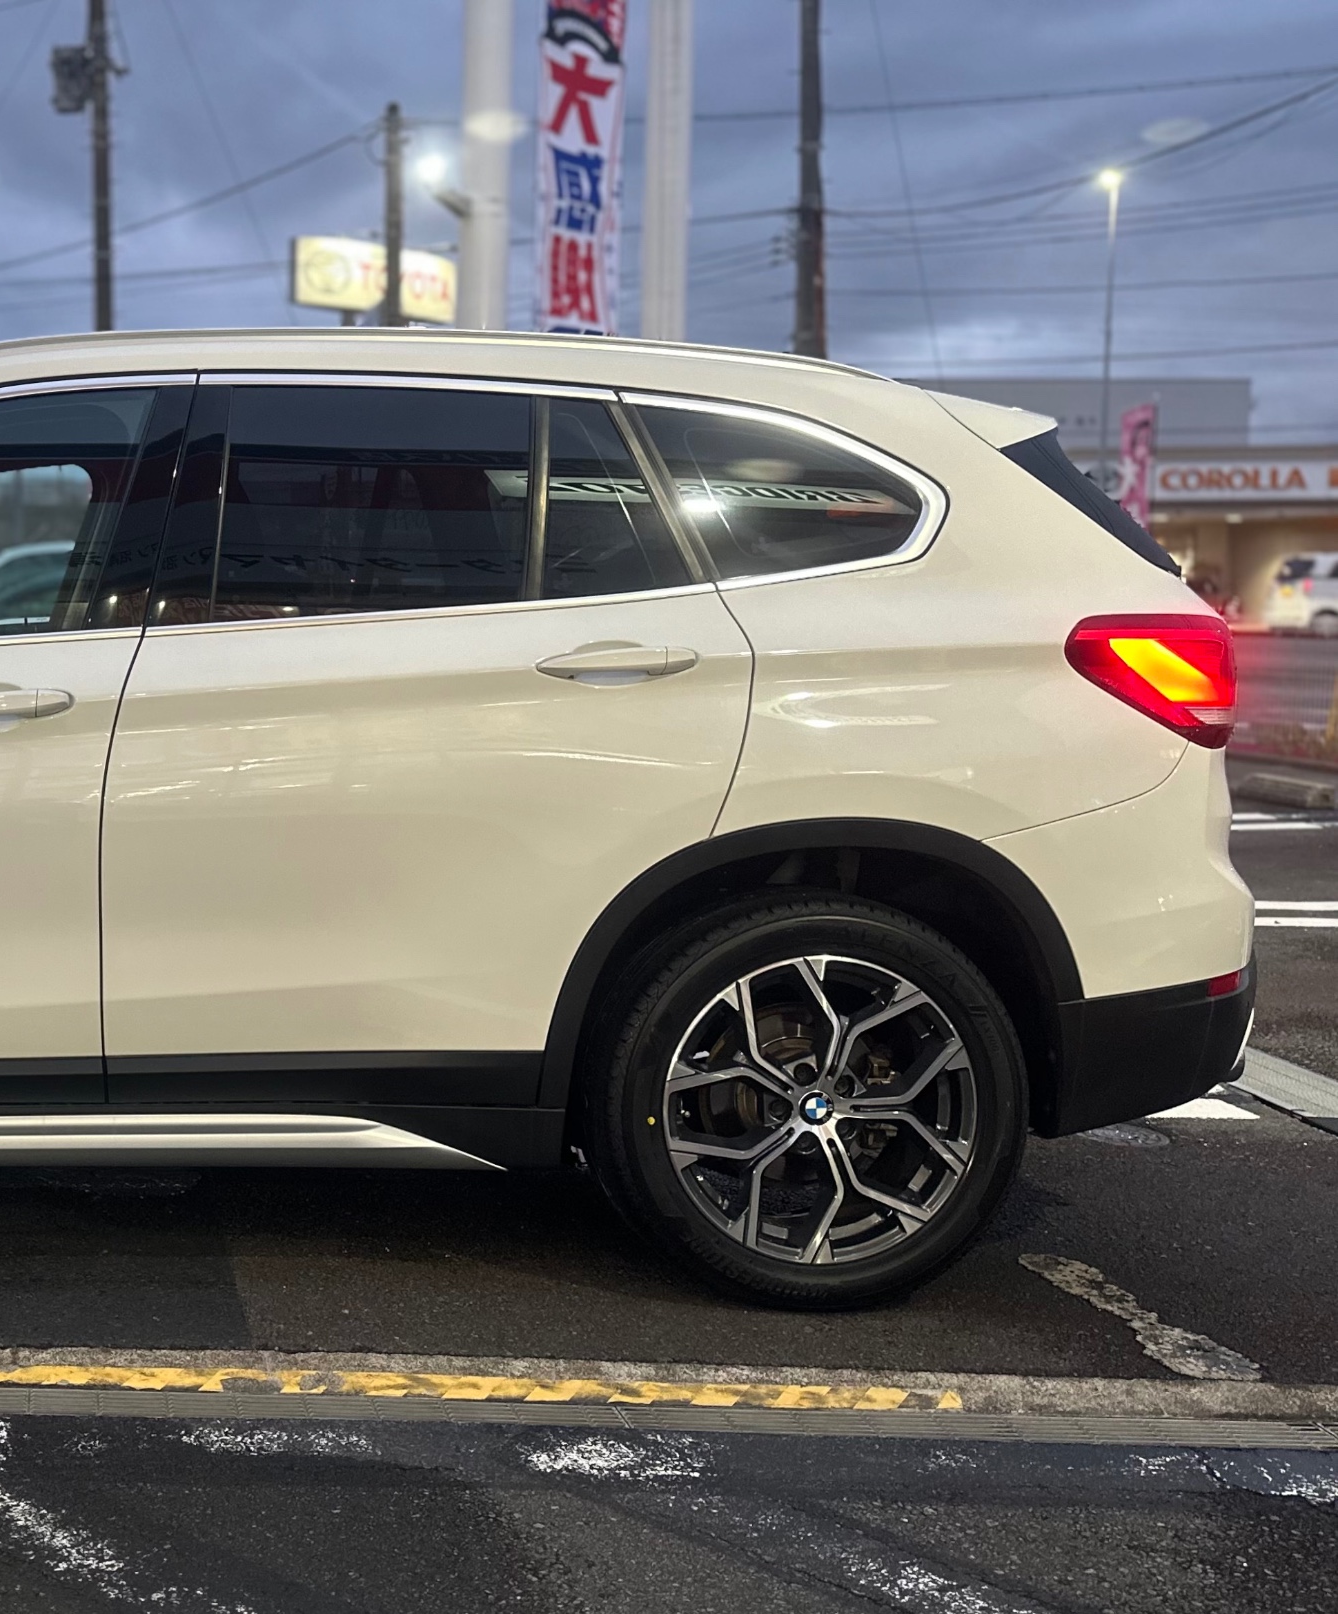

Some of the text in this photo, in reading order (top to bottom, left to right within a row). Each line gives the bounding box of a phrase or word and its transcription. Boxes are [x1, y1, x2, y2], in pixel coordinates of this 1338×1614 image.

[546, 50, 615, 335] 大感謝
[358, 262, 451, 302] TOOTA
[1160, 466, 1307, 491] COROLLA
